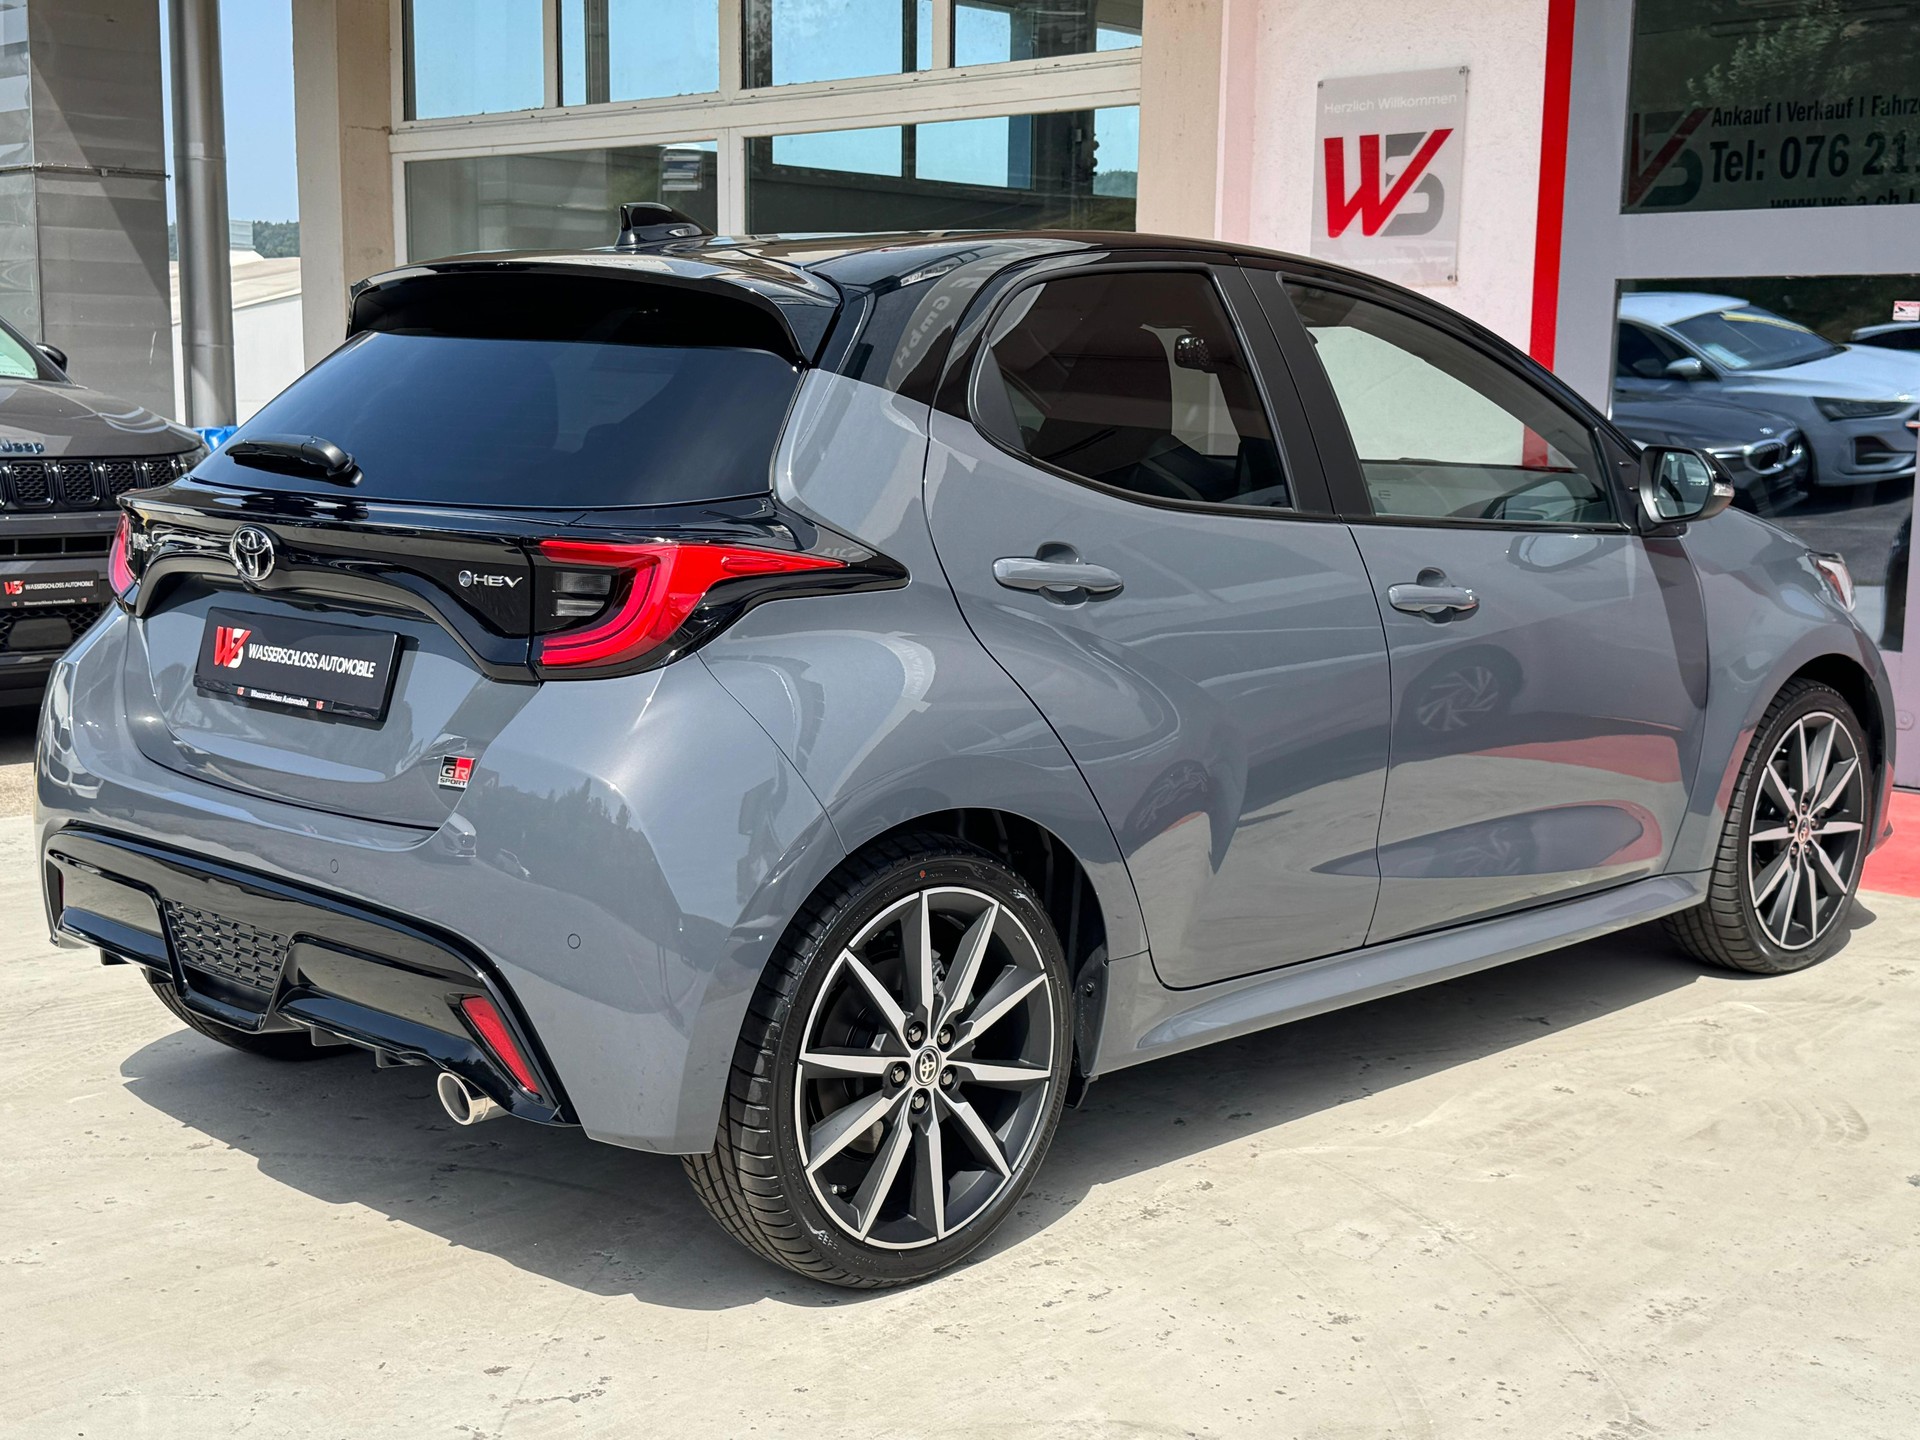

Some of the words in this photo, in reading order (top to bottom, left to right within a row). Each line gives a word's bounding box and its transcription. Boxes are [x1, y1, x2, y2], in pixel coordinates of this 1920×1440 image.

[1323, 99, 1375, 115] Herzlich
[1377, 92, 1457, 111] Willkommen
[1710, 102, 1772, 127] Ankauf
[1785, 95, 1854, 122] Verkauf
[1871, 93, 1920, 117] Fahrz
[1710, 138, 1766, 184] Tel:
[1778, 133, 1850, 181] 076
[248, 643, 318, 669] WASSERSCHLOSS
[317, 656, 377, 678] AUTOMOBILE
[439, 777, 467, 786] SPORT
[441, 764, 469, 780] GR
